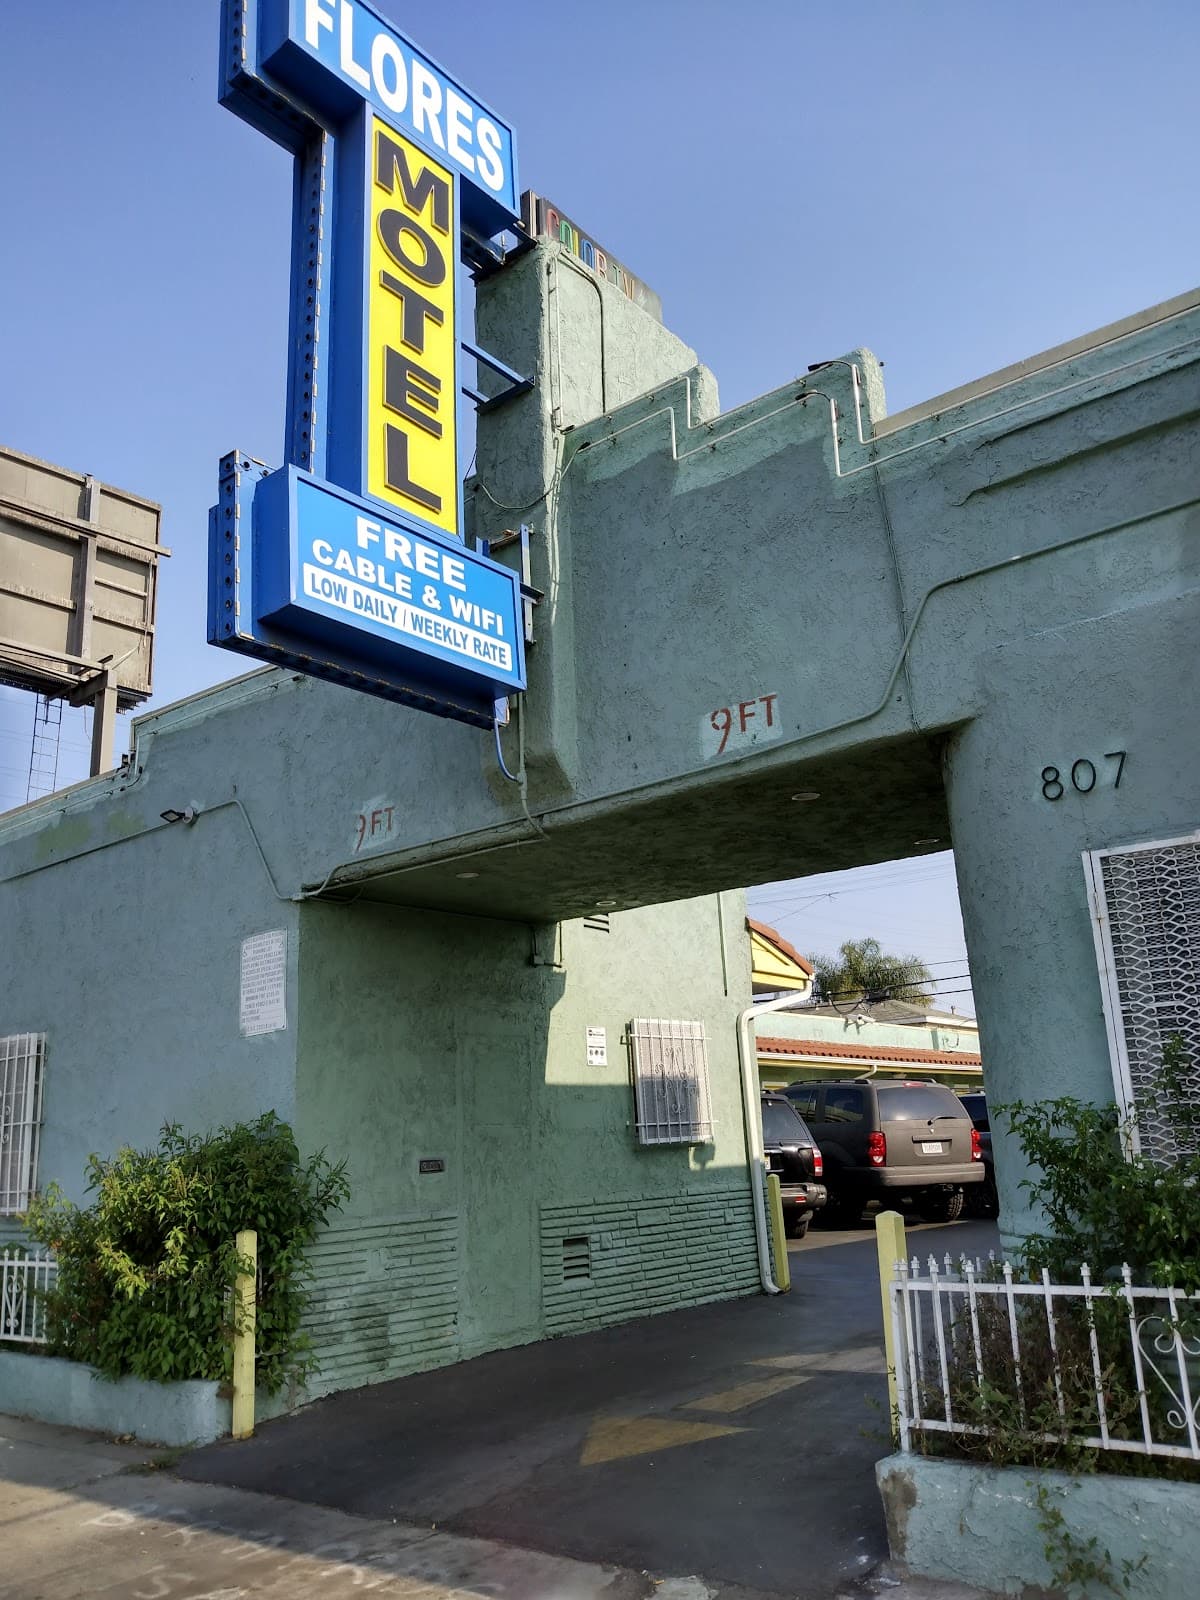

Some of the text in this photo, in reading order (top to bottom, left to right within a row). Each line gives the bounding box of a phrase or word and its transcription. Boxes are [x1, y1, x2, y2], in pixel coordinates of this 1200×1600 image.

[304, 0, 504, 191] FLORES
[375, 130, 450, 514] MOTEL
[312, 540, 504, 637] CABLE & WIFI
[356, 516, 466, 592] FREE
[311, 573, 348, 605] LOW
[353, 589, 398, 623] DAILY
[410, 611, 468, 650] WEEKLY
[473, 636, 508, 666] RATE
[1041, 750, 1127, 801] 807
